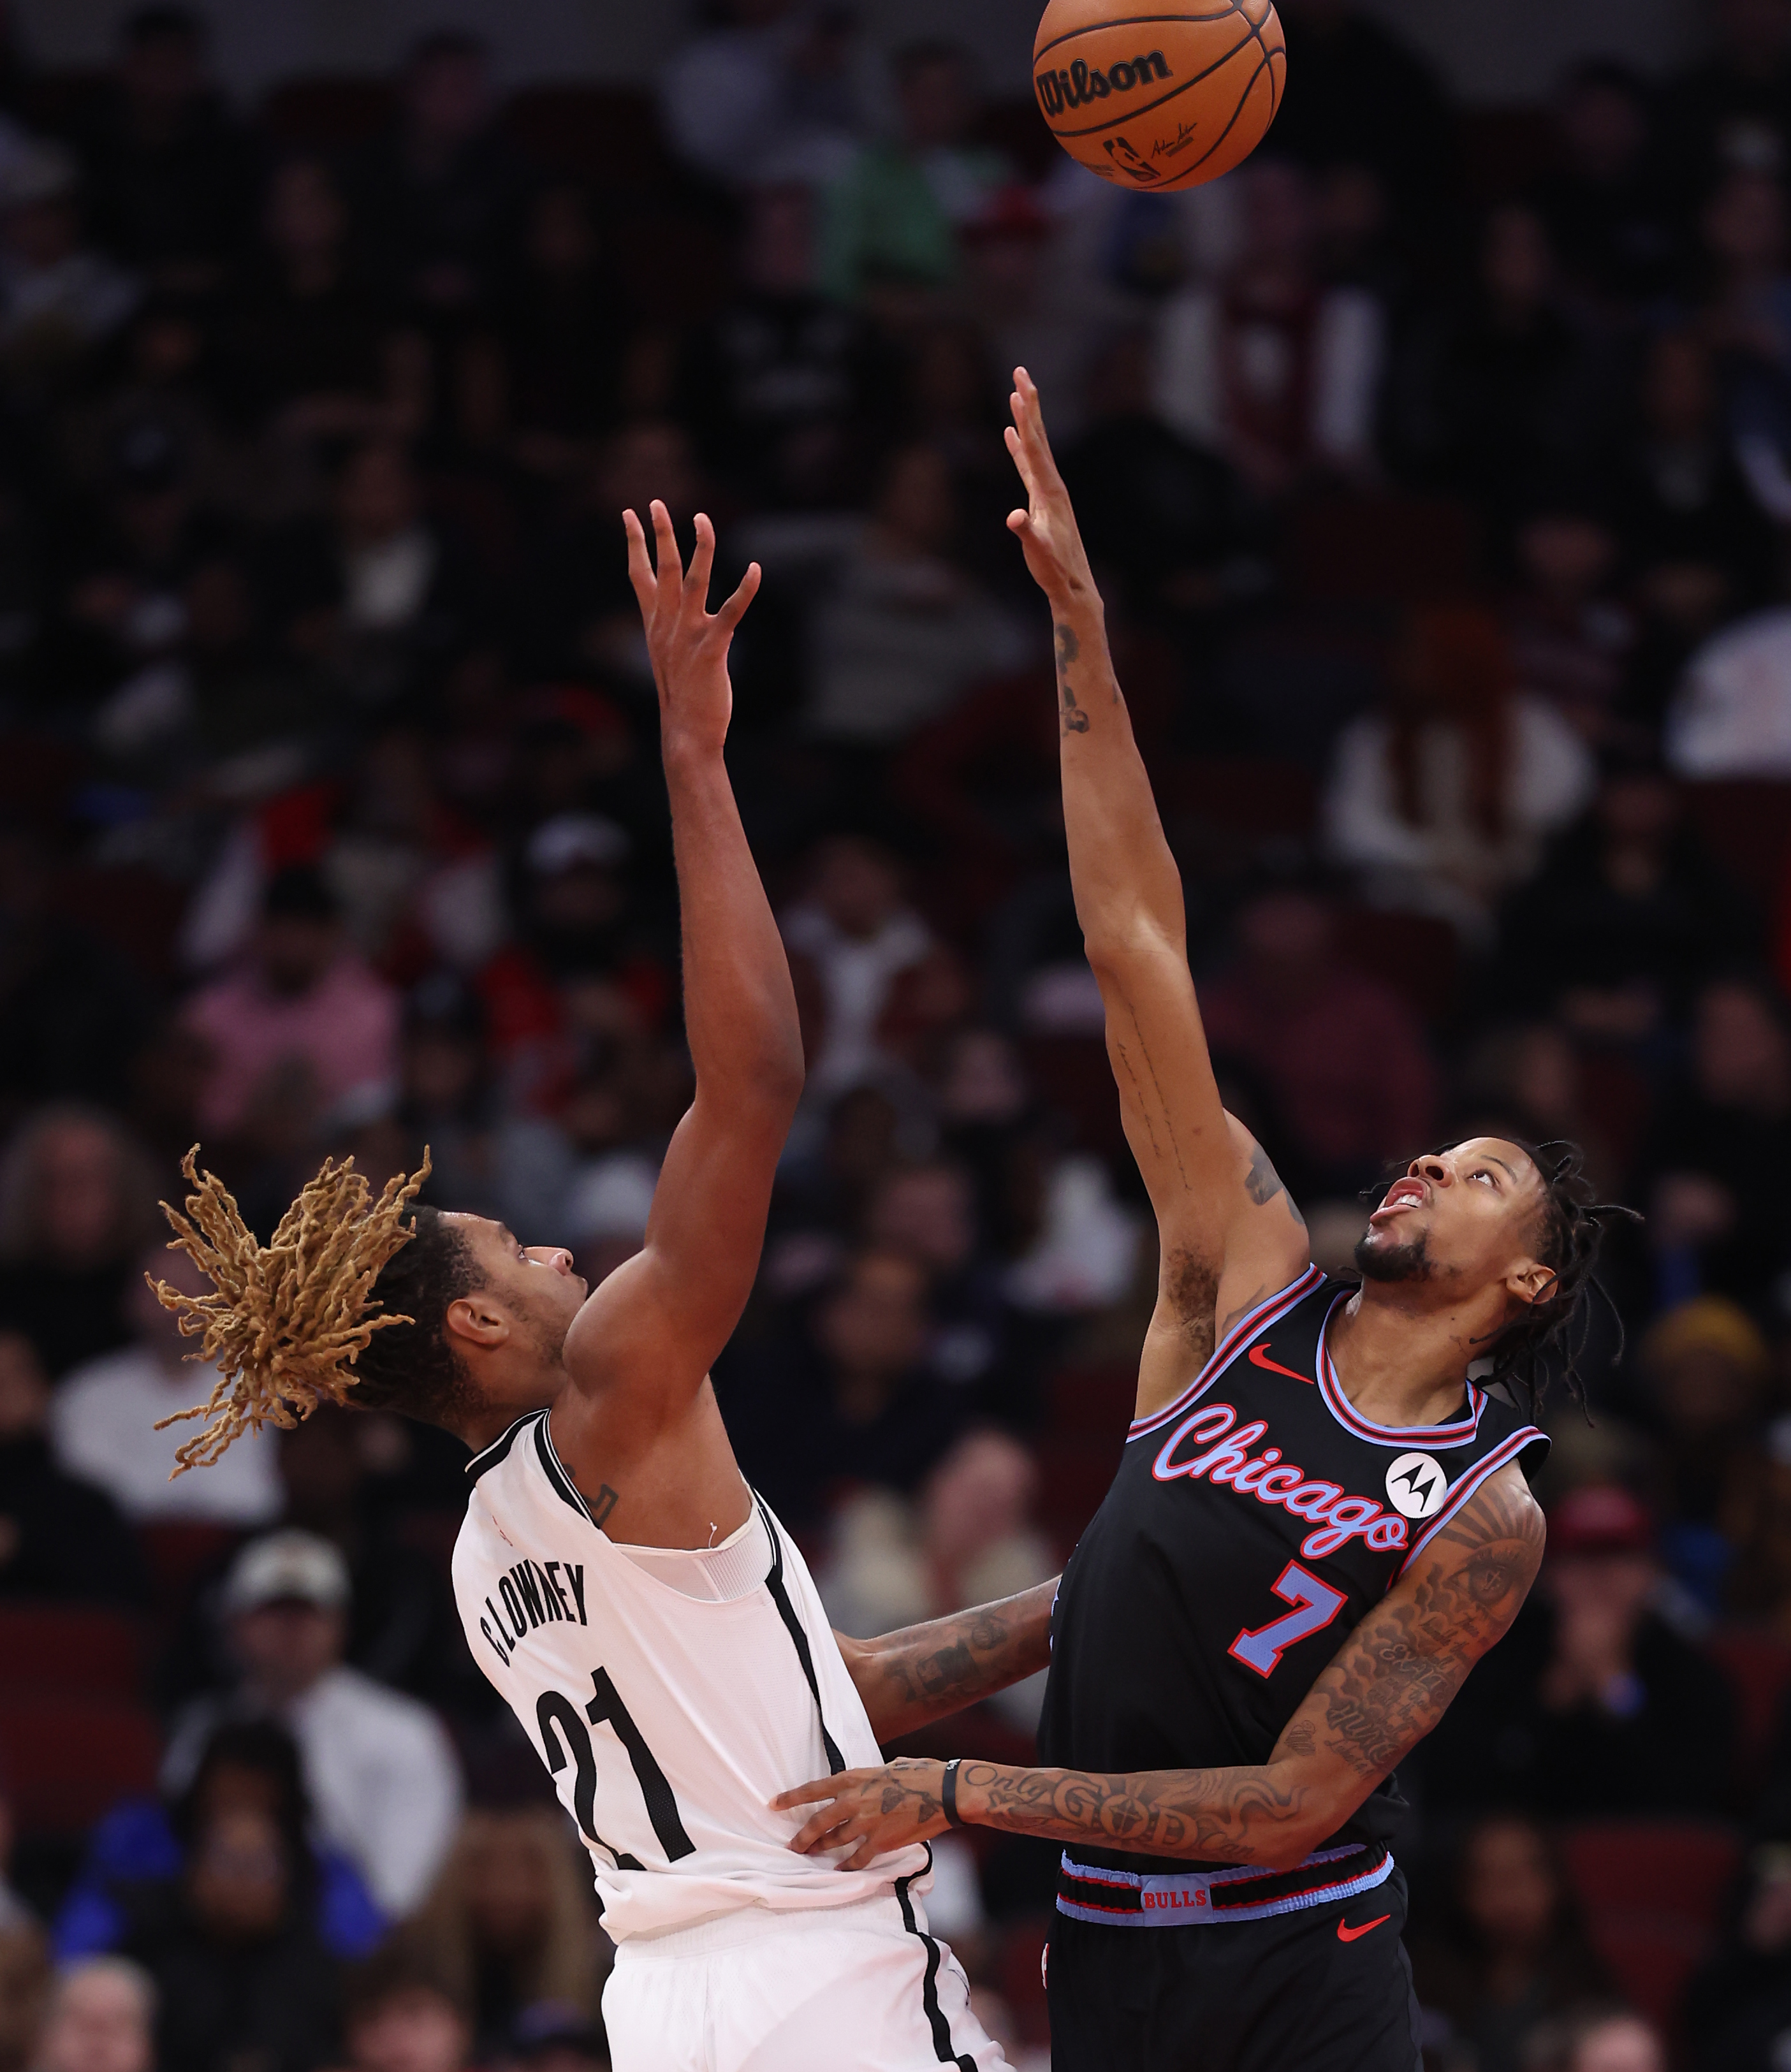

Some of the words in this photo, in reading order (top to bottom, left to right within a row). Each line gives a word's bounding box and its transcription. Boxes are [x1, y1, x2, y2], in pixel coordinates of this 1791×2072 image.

[1036, 50, 1173, 117] Wilson
[1152, 1404, 1408, 1559] Chicago
[480, 1559, 588, 1667] CLOWNEY
[1227, 1559, 1349, 1679] 7
[536, 1666, 697, 1871] 21
[964, 1765, 1049, 1805] Only
[1053, 1776, 1199, 1849] GOD
[1143, 1889, 1206, 1909] BULLS
